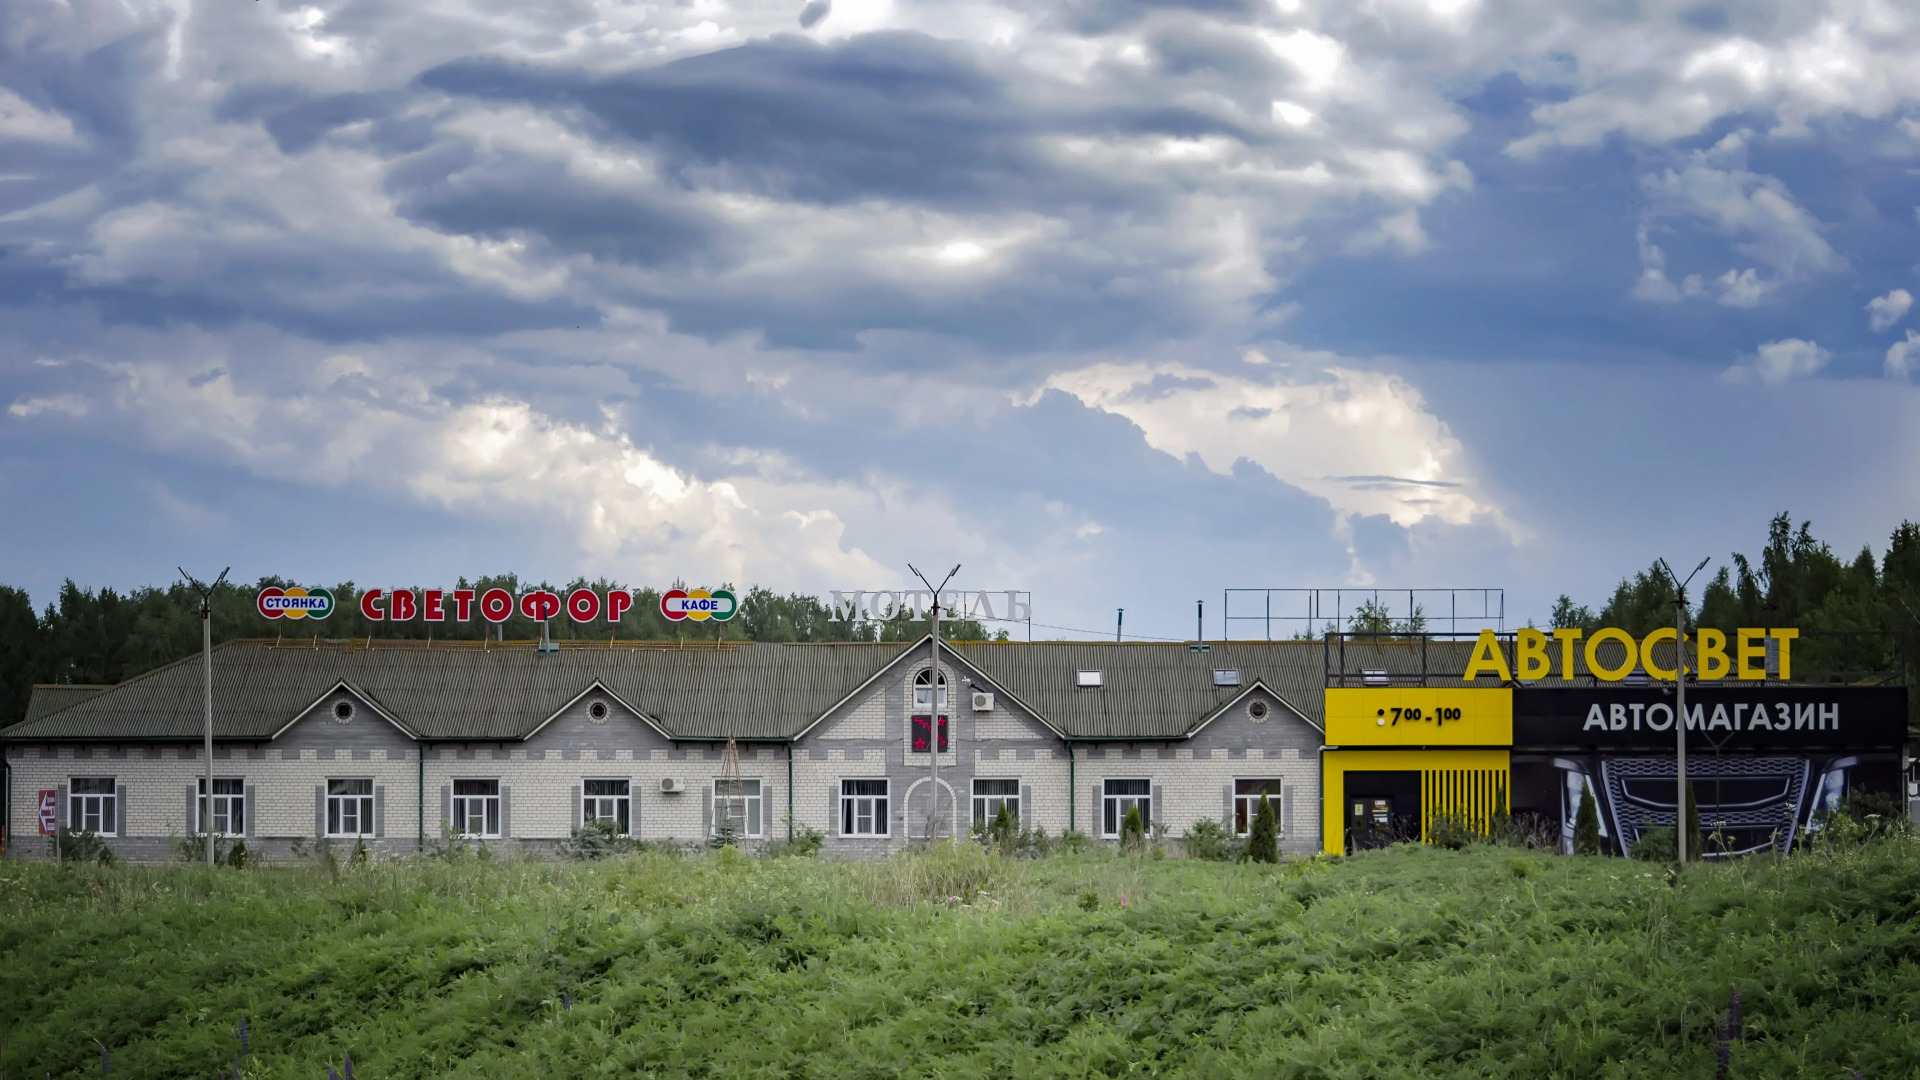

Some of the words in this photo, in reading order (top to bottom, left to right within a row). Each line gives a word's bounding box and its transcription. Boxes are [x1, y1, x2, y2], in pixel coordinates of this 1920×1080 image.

[265, 597, 326, 609] СТОЯНКА
[360, 588, 632, 622] СВЕТОФОР
[681, 599, 718, 610] КАФЕ
[827, 590, 1032, 622] МОТЕЛЬ
[1462, 627, 1799, 682] АВТОСВЕТ
[1583, 703, 1839, 732] АВТОМАГАЗИН
